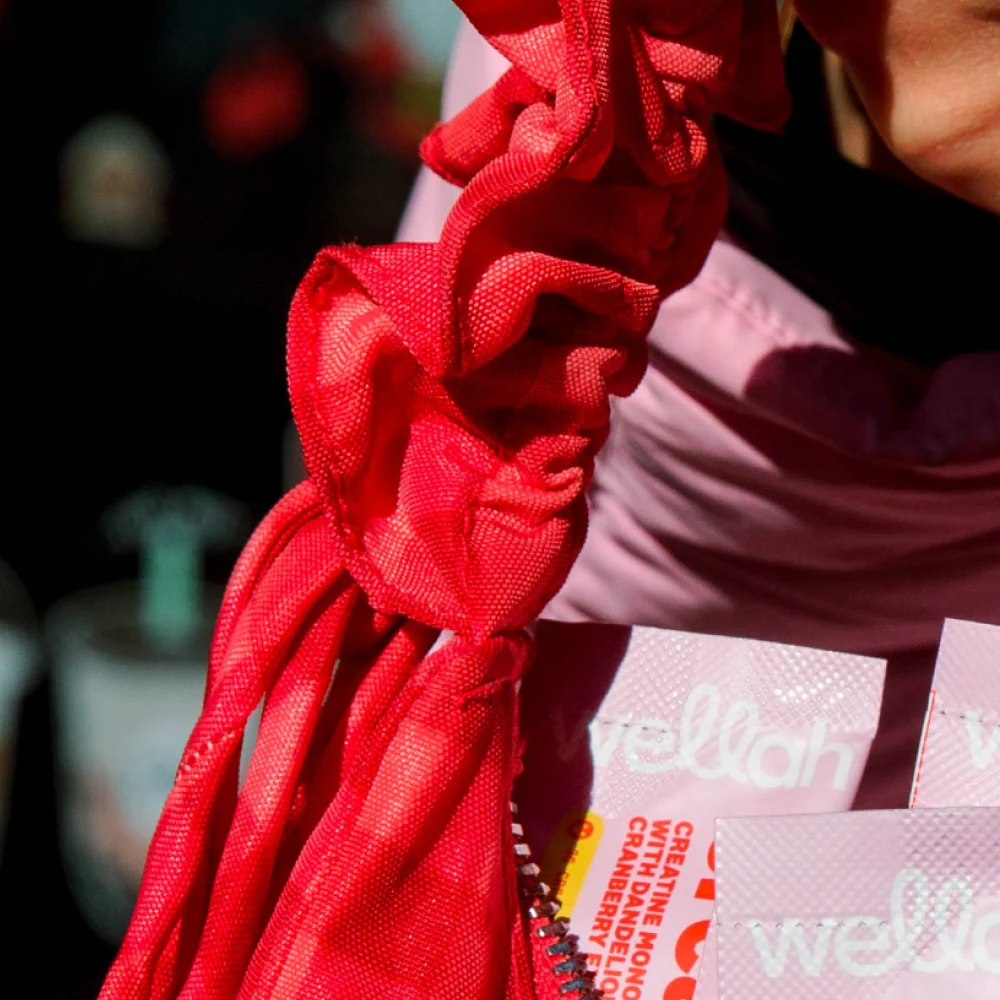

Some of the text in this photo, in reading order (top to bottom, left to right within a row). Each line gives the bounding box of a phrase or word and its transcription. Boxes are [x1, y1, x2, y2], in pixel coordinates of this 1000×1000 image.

[553, 683, 854, 791] wellah
[588, 816, 647, 948] CRANBERRY
[636, 819, 672, 877] WITH
[642, 821, 694, 927] CREATINE
